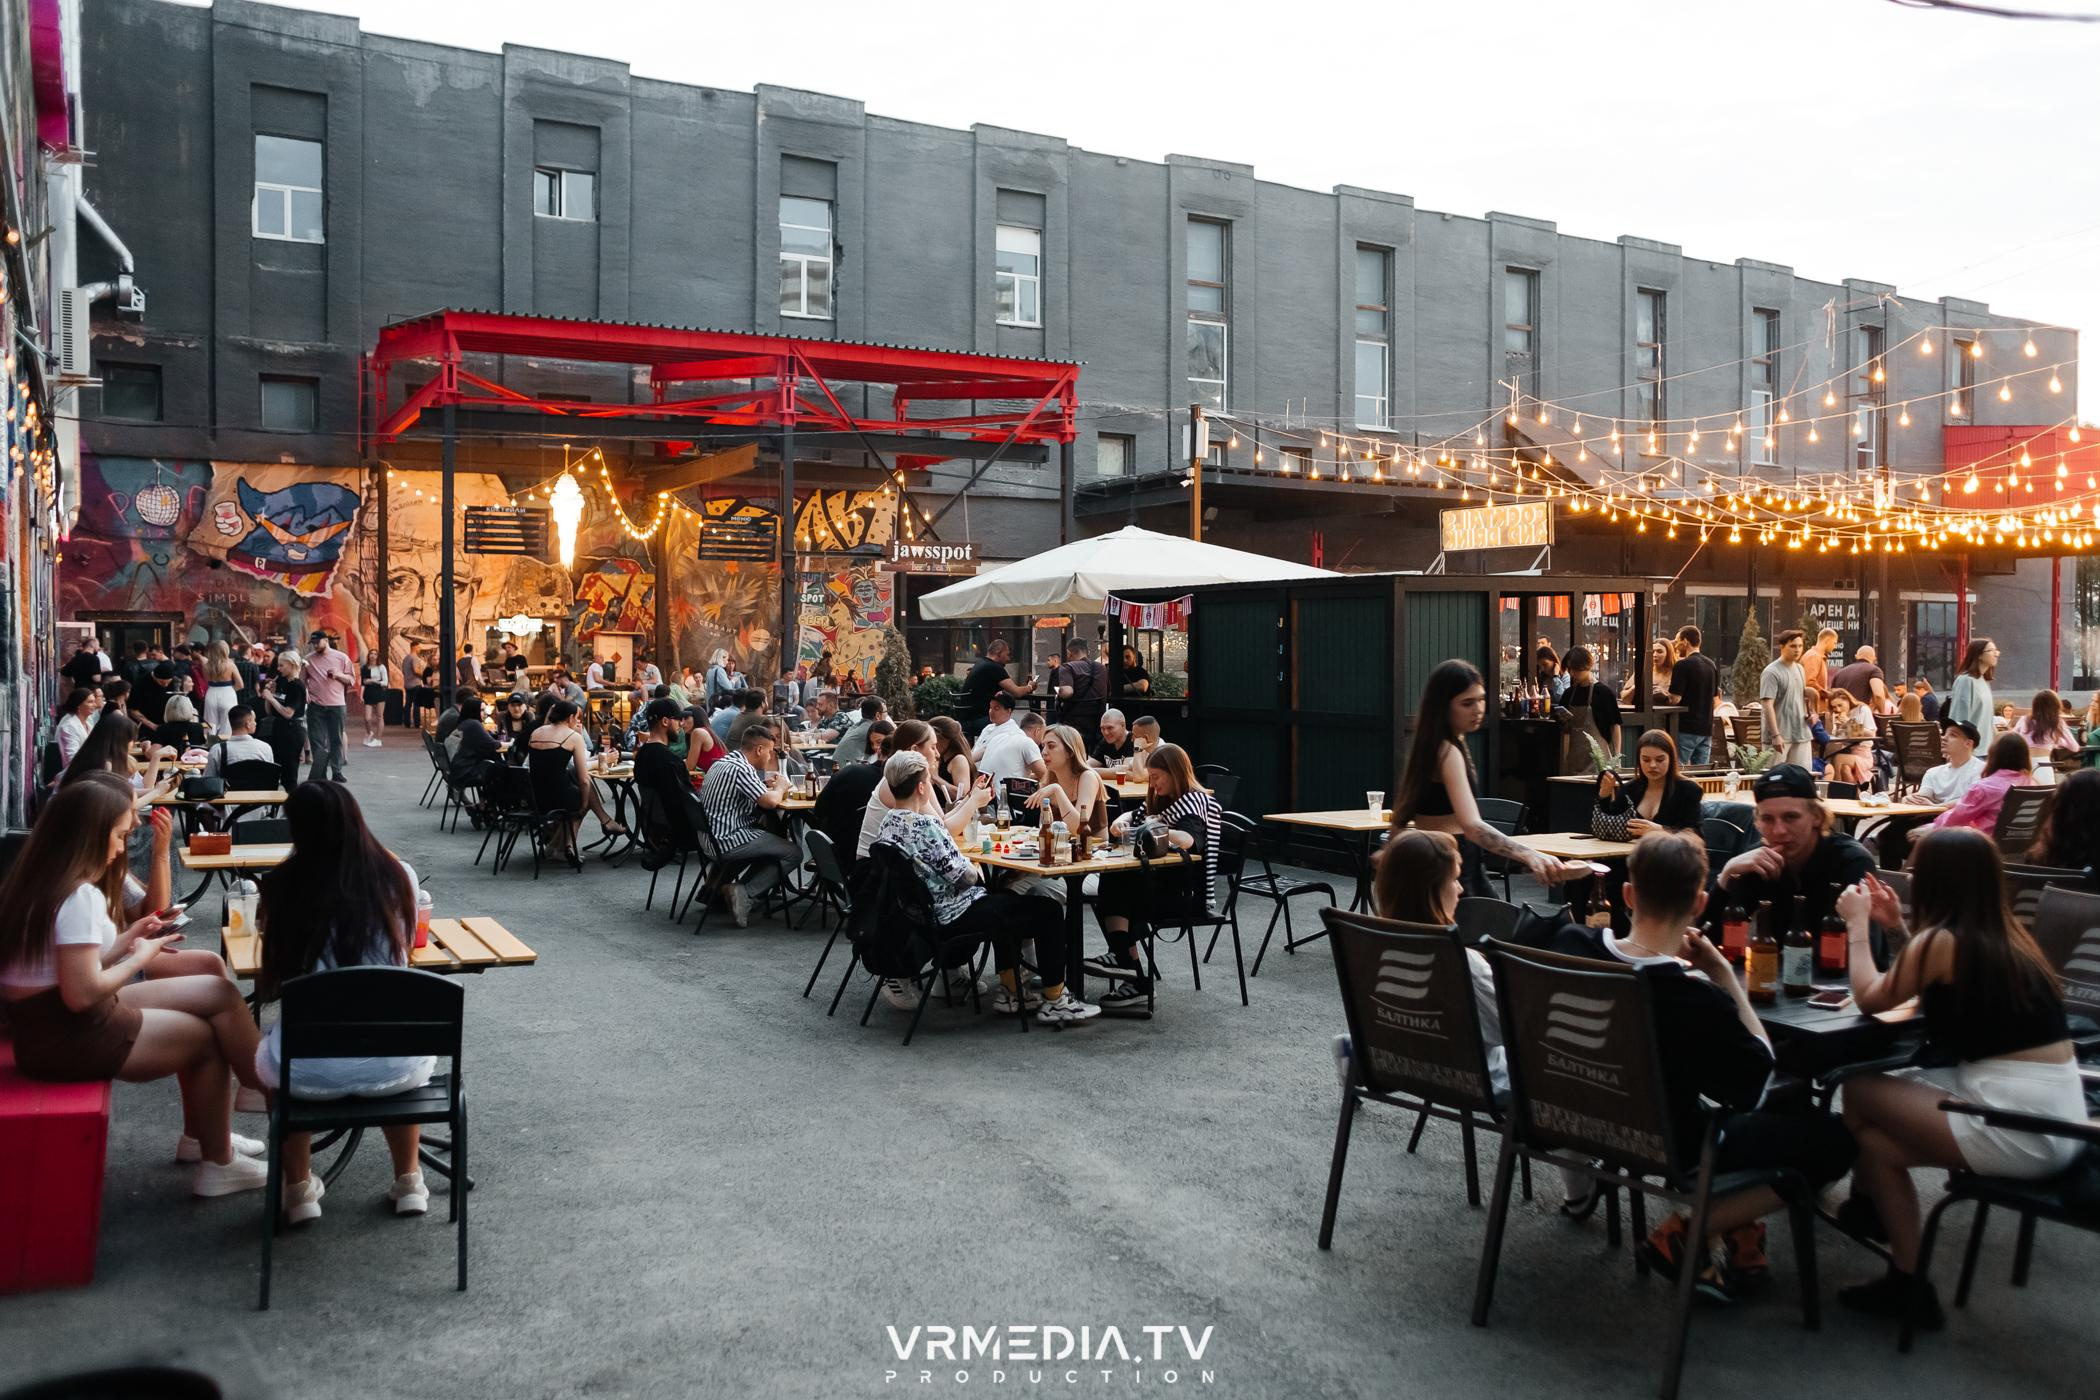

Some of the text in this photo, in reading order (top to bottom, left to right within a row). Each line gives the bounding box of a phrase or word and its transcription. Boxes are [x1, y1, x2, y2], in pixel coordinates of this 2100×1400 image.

[892, 541, 973, 564] jawsspot
[800, 593, 825, 603] SPOT
[1810, 604, 1860, 619] АРЕНД
[1377, 1006, 1441, 1031] БАЛТИКА
[1547, 1053, 1620, 1085] БАЛТИКА
